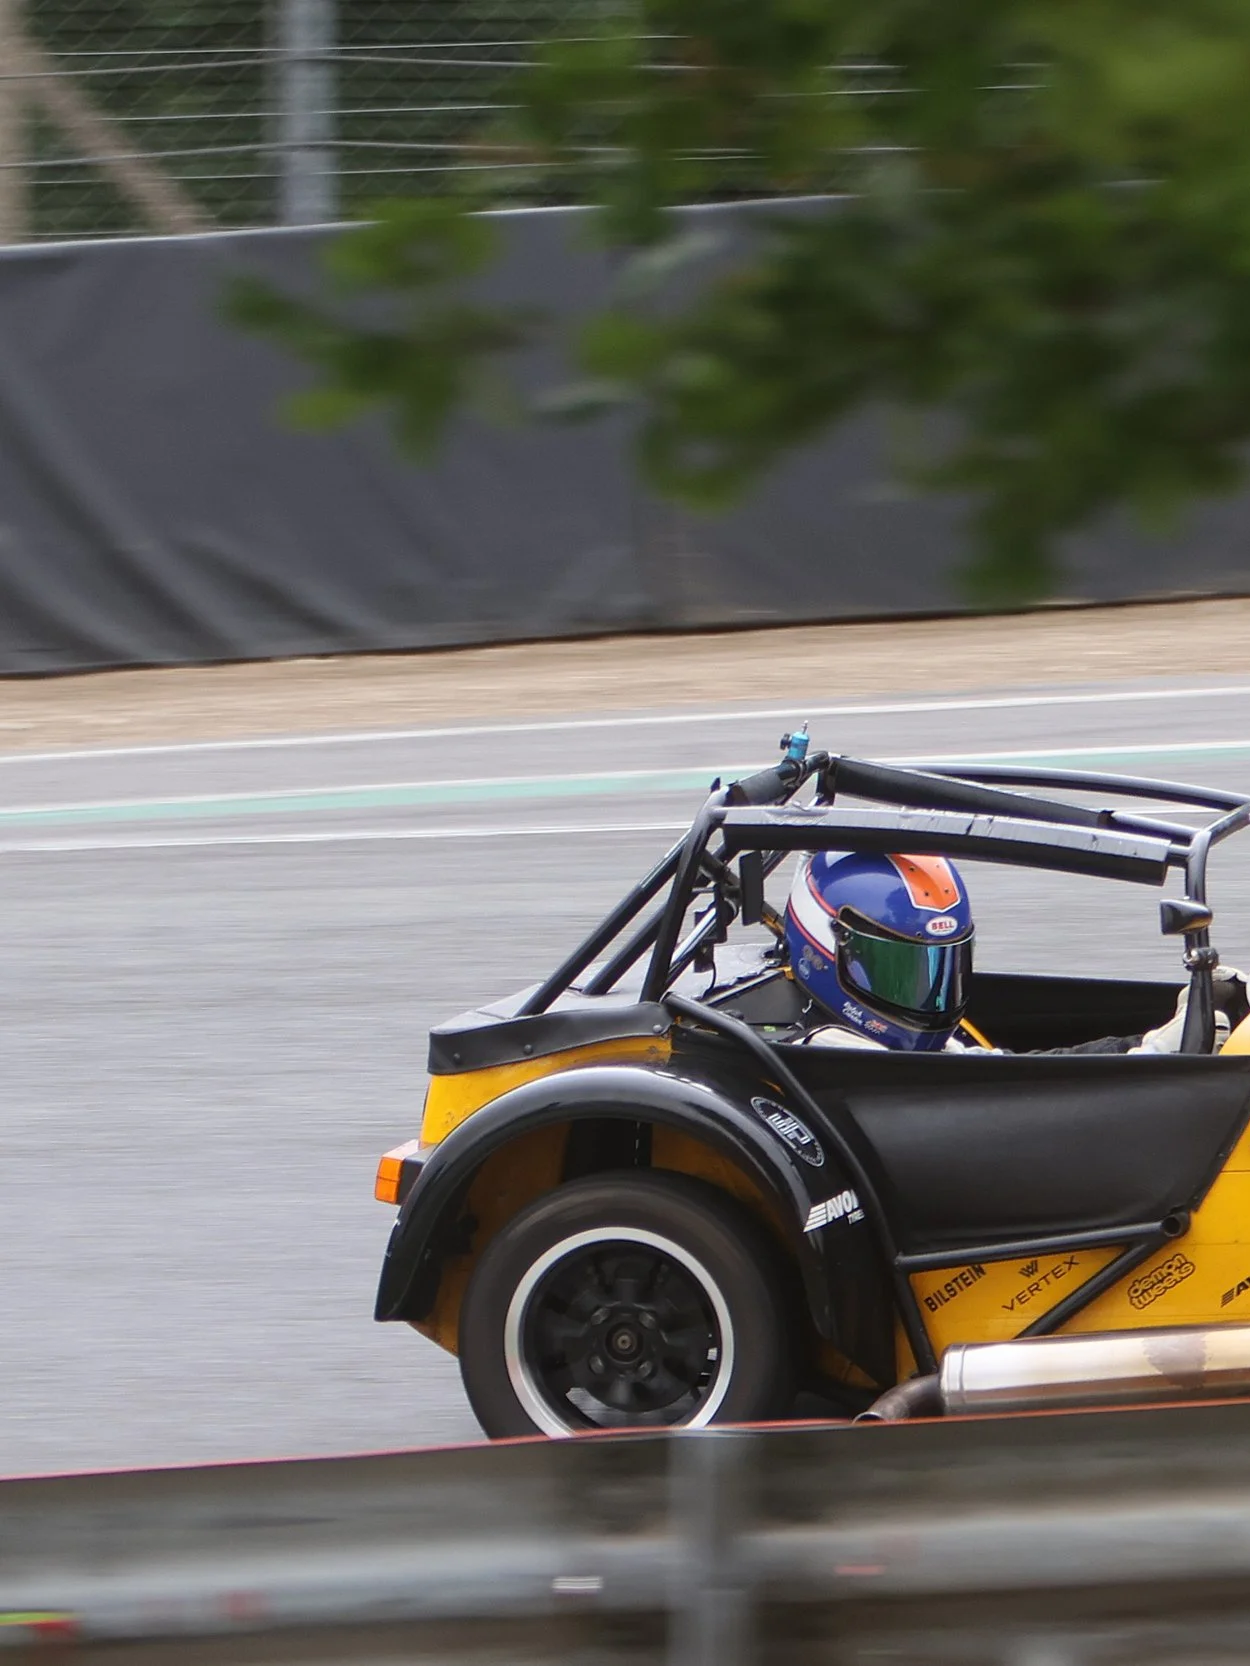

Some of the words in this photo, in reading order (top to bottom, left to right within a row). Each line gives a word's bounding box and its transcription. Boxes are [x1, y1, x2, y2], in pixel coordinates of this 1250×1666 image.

[931, 921, 955, 930] BELL
[924, 1263, 987, 1312] BILSTEIN
[1001, 1255, 1080, 1311] VERTEX
[1128, 1254, 1187, 1298] demon
[1130, 1262, 1196, 1309] tweeks
